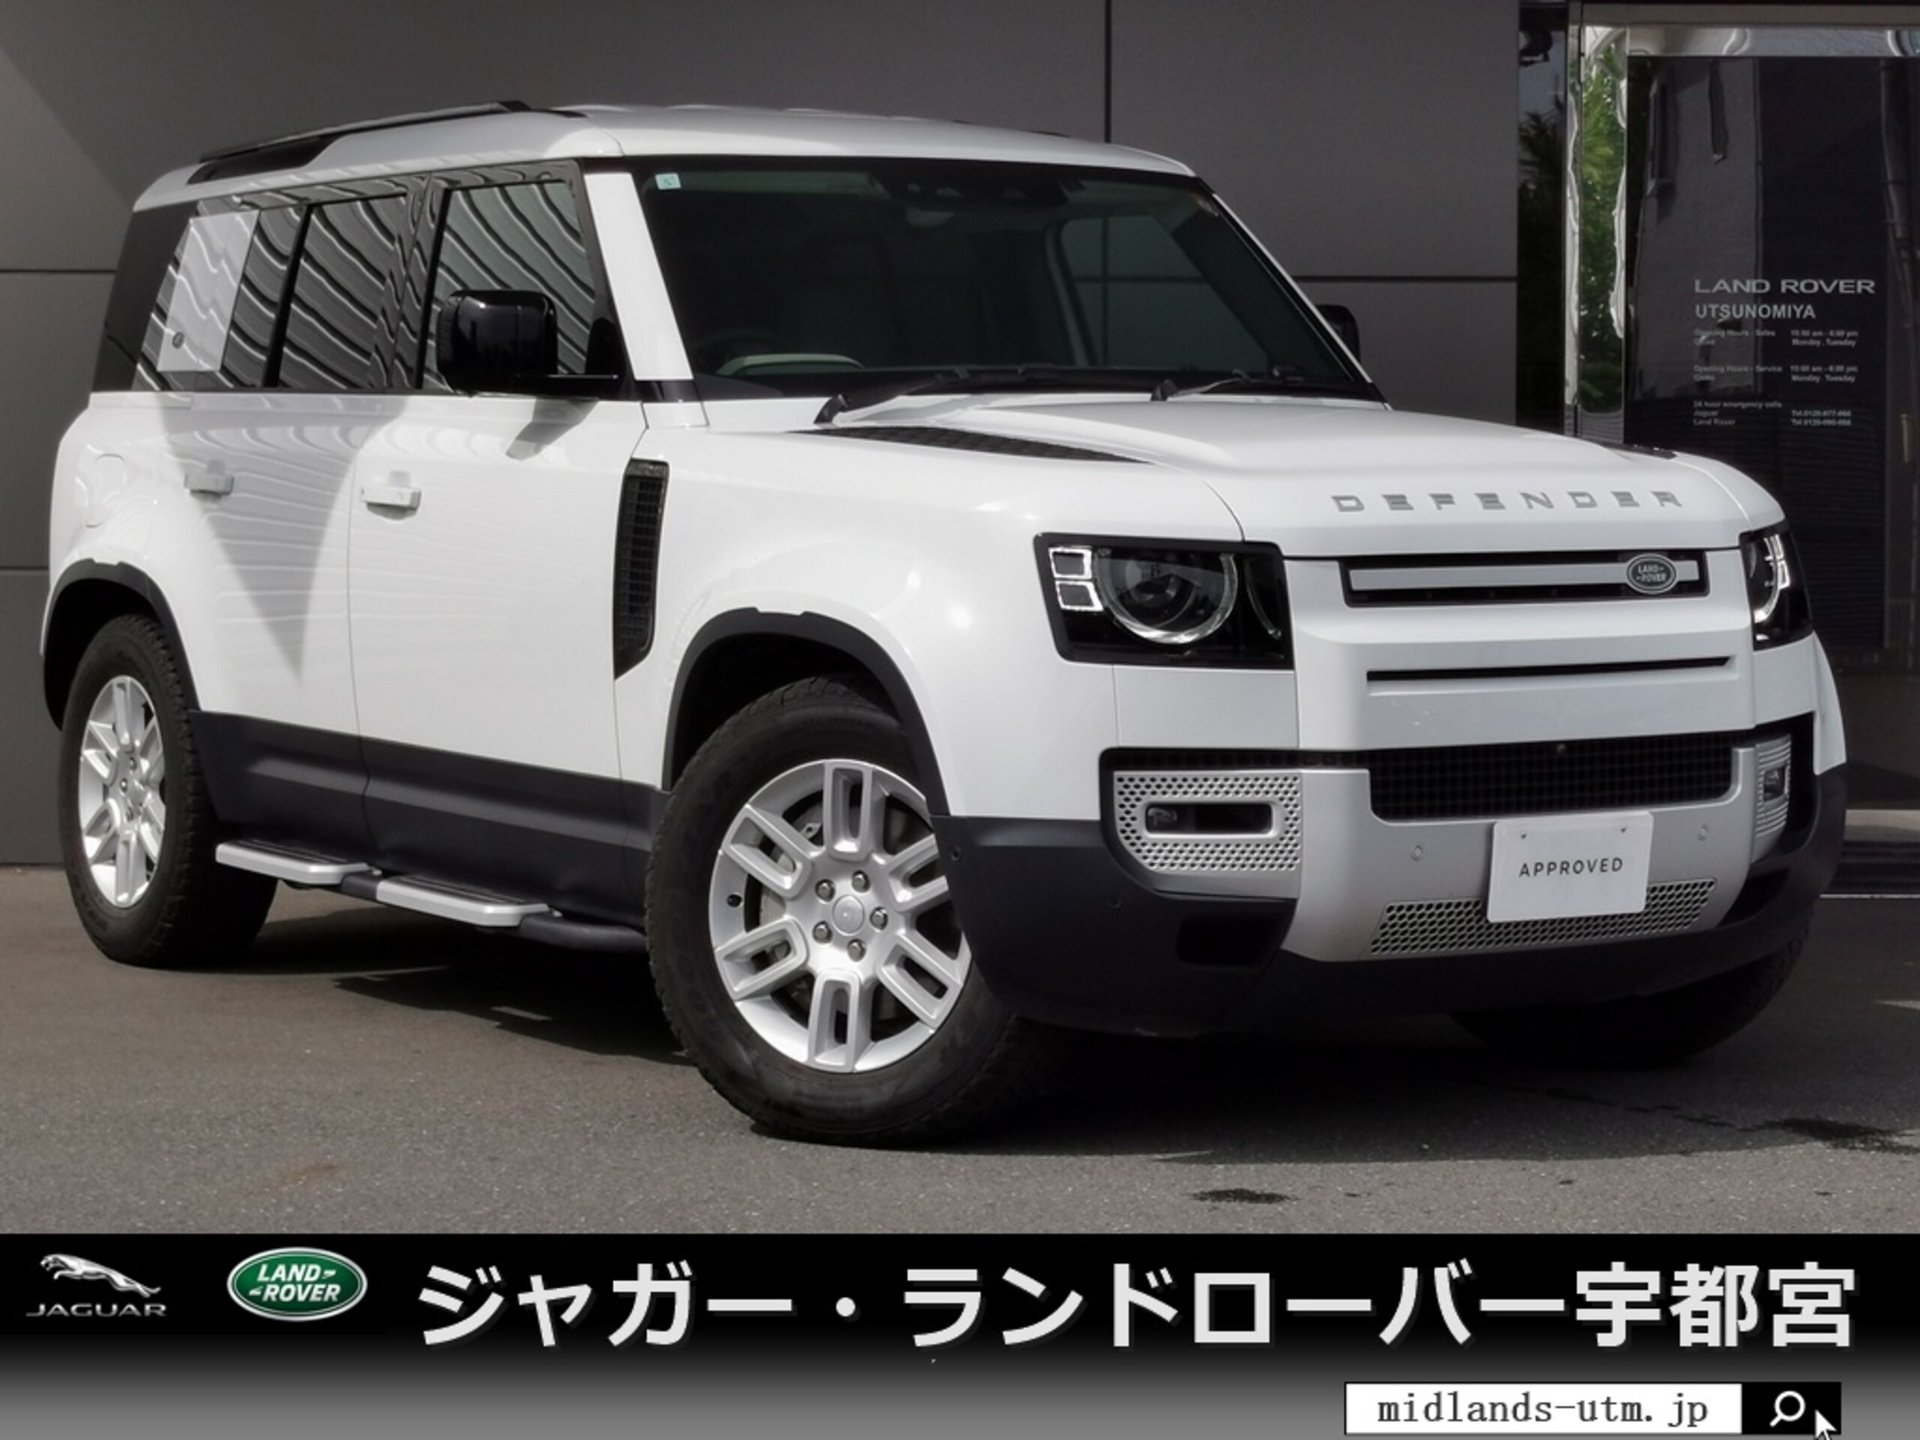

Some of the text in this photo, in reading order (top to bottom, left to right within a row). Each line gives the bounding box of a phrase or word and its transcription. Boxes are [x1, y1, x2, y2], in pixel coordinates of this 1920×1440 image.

[1694, 279, 1876, 293] LAND ROVER
[1695, 304, 1816, 319] UTSUNOMIYA
[1331, 491, 1684, 512] DEFENDER
[1519, 857, 1623, 878] APPROVED
